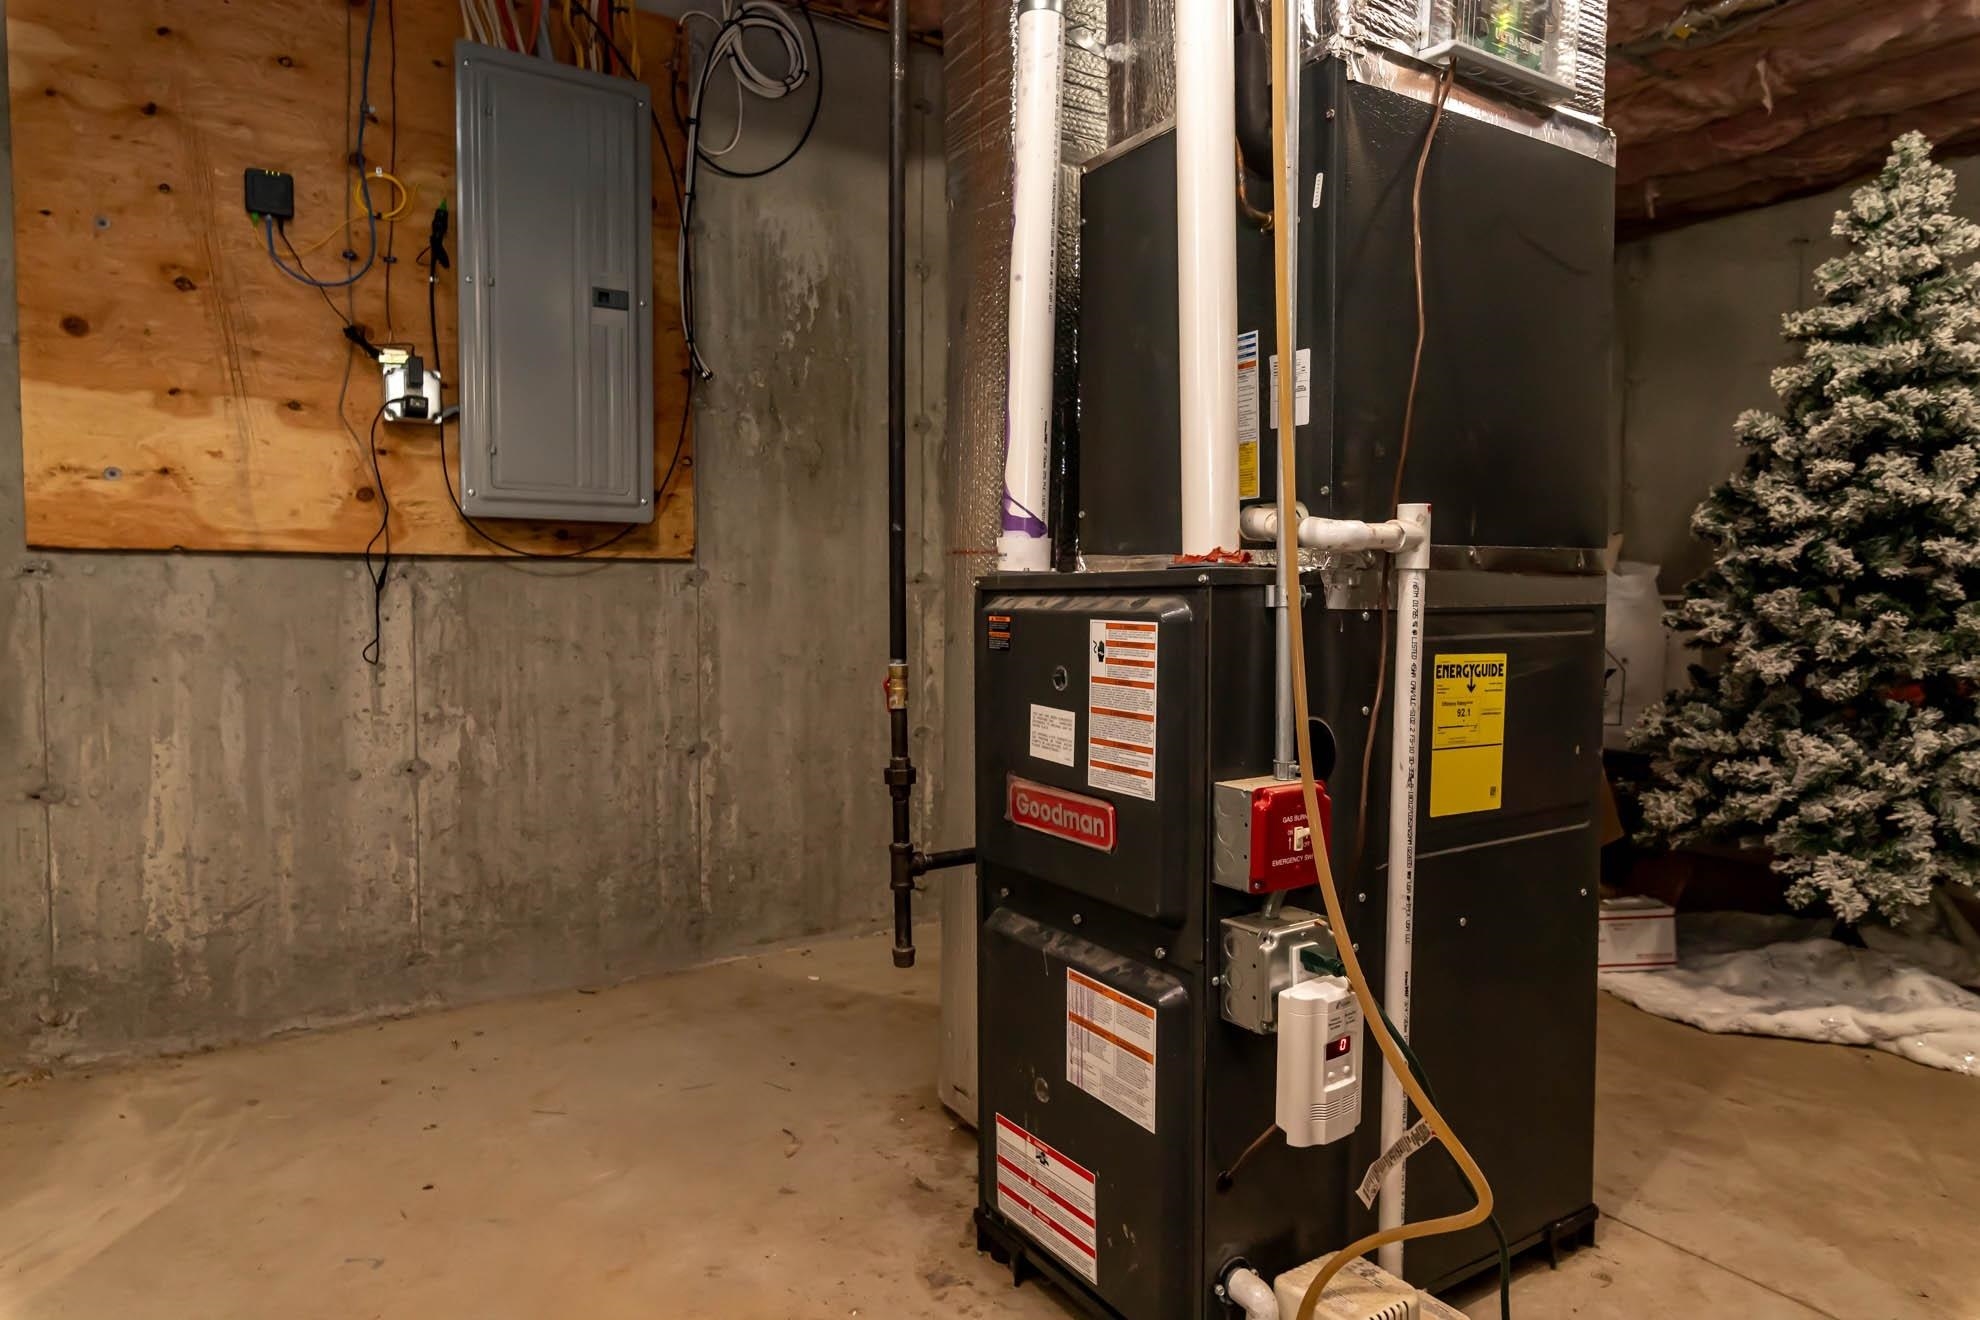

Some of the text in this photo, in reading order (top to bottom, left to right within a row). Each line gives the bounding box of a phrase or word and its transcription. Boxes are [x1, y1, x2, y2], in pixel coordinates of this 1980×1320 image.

[1436, 664, 1504, 679] ENERGYGUIDE
[1016, 793, 1105, 838] Goodman
[1272, 856, 1303, 867] EMERGENCY
[1339, 1038, 1347, 1051] 0
